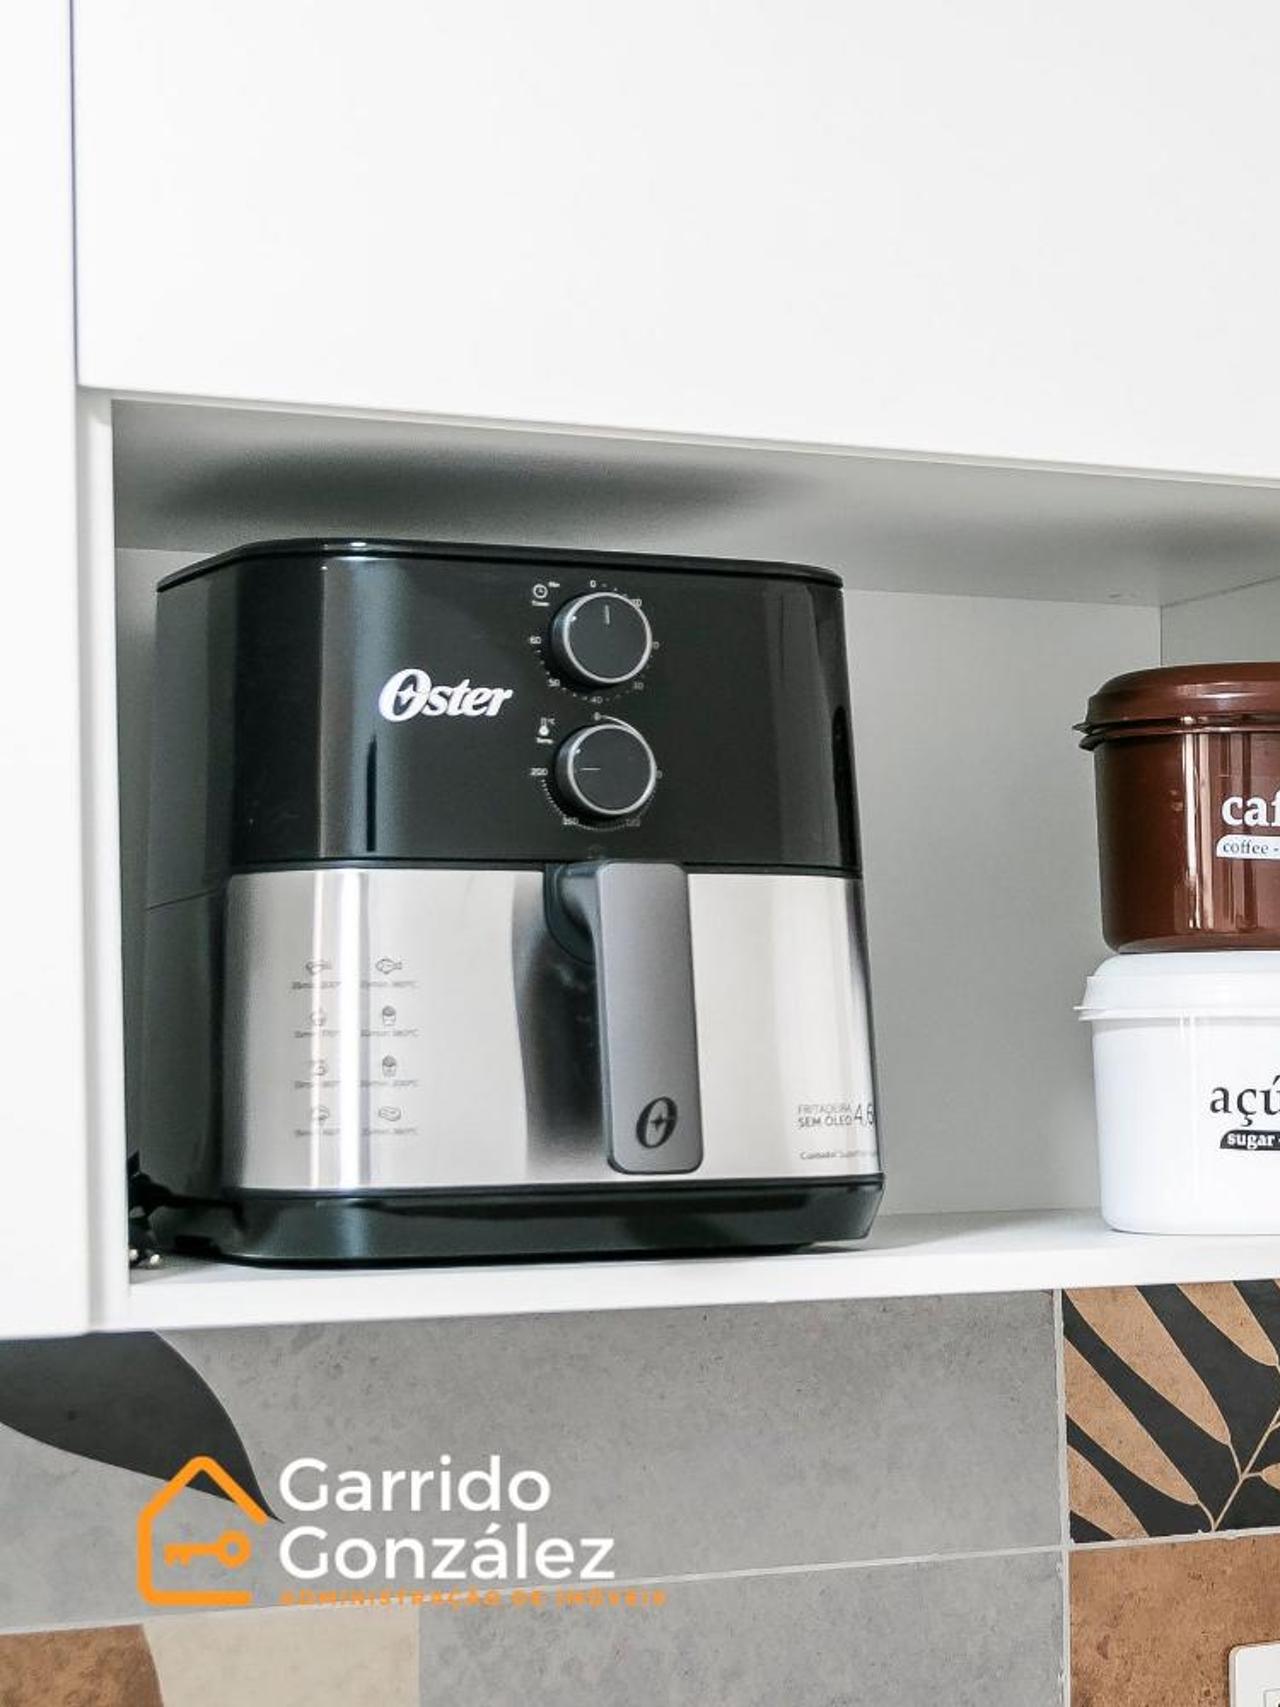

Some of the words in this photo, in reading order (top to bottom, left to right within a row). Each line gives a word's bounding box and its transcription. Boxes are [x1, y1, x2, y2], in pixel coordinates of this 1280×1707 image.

[379, 668, 514, 722] Oster
[1222, 840, 1270, 855] coffee
[1226, 1132, 1276, 1150] sugar
